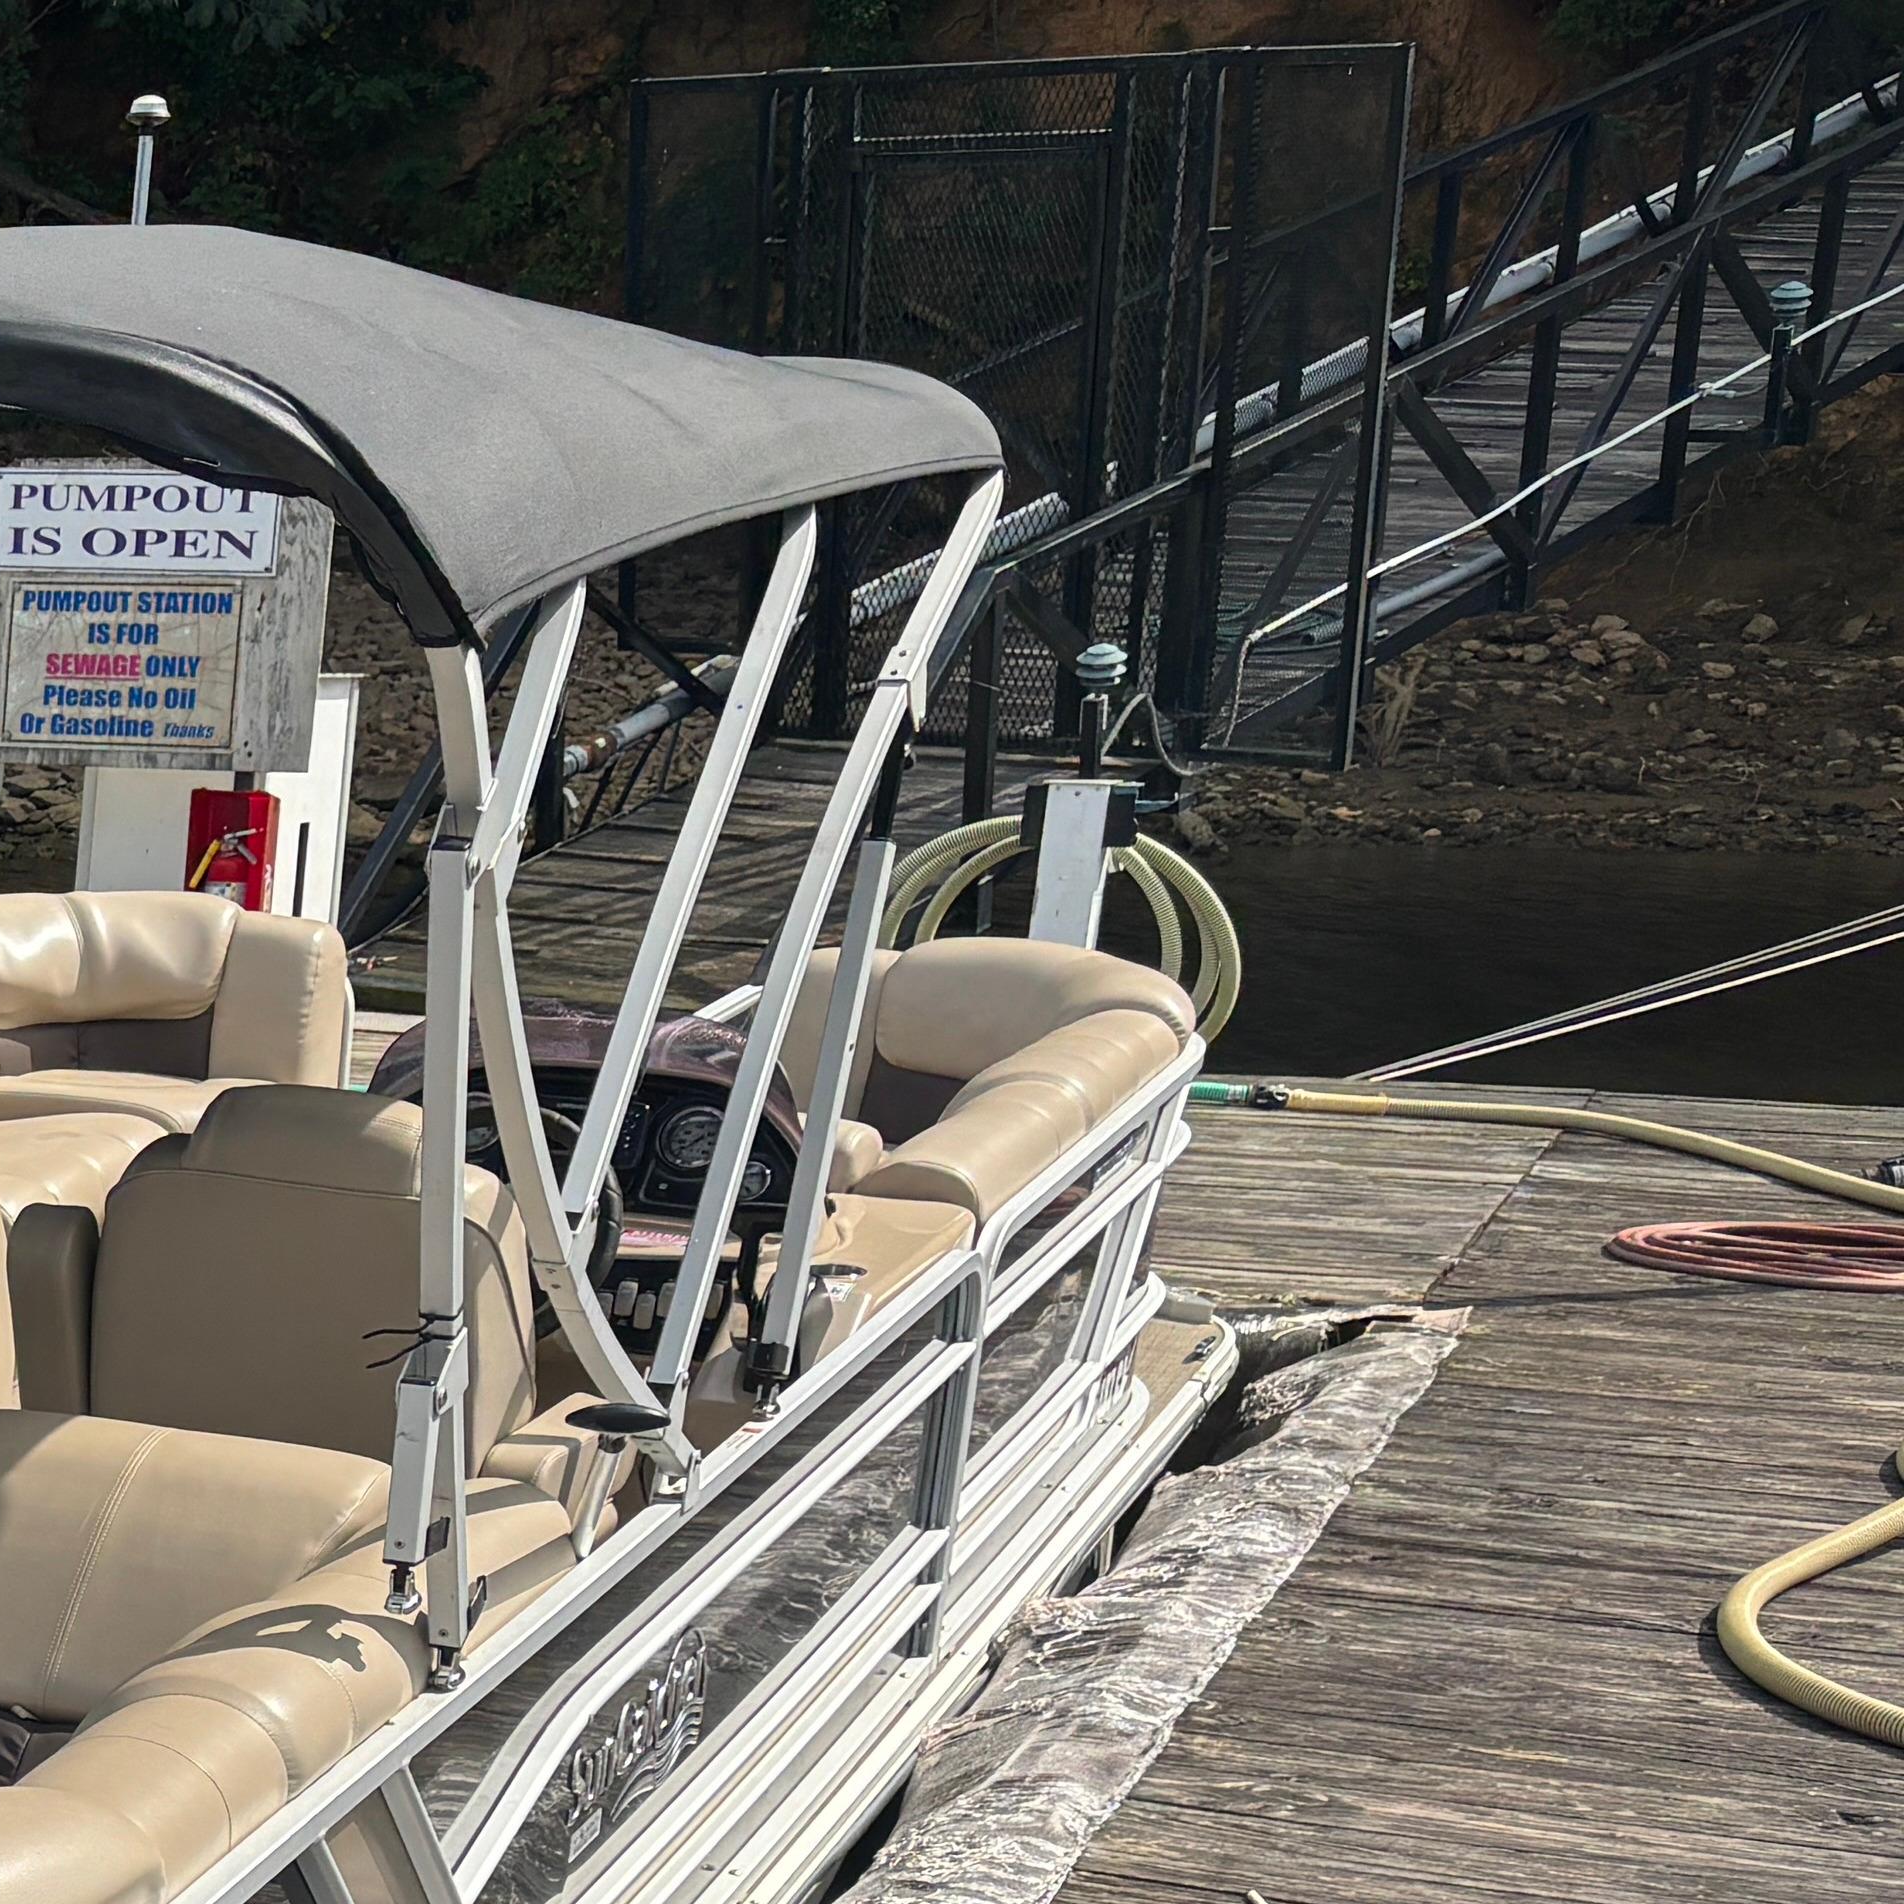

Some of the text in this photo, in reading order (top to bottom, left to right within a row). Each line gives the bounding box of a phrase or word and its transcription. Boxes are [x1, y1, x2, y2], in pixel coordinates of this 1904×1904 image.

[9, 484, 264, 514] PUMPOUT
[8, 527, 259, 560] IS OPEN
[22, 591, 233, 615] PUMPOUT STATION
[88, 624, 159, 645] IS FOR
[45, 653, 202, 679] SEWAGE ONLY
[43, 685, 197, 710] Please No Oil
[20, 713, 216, 740] Or Gasoline Thanks
